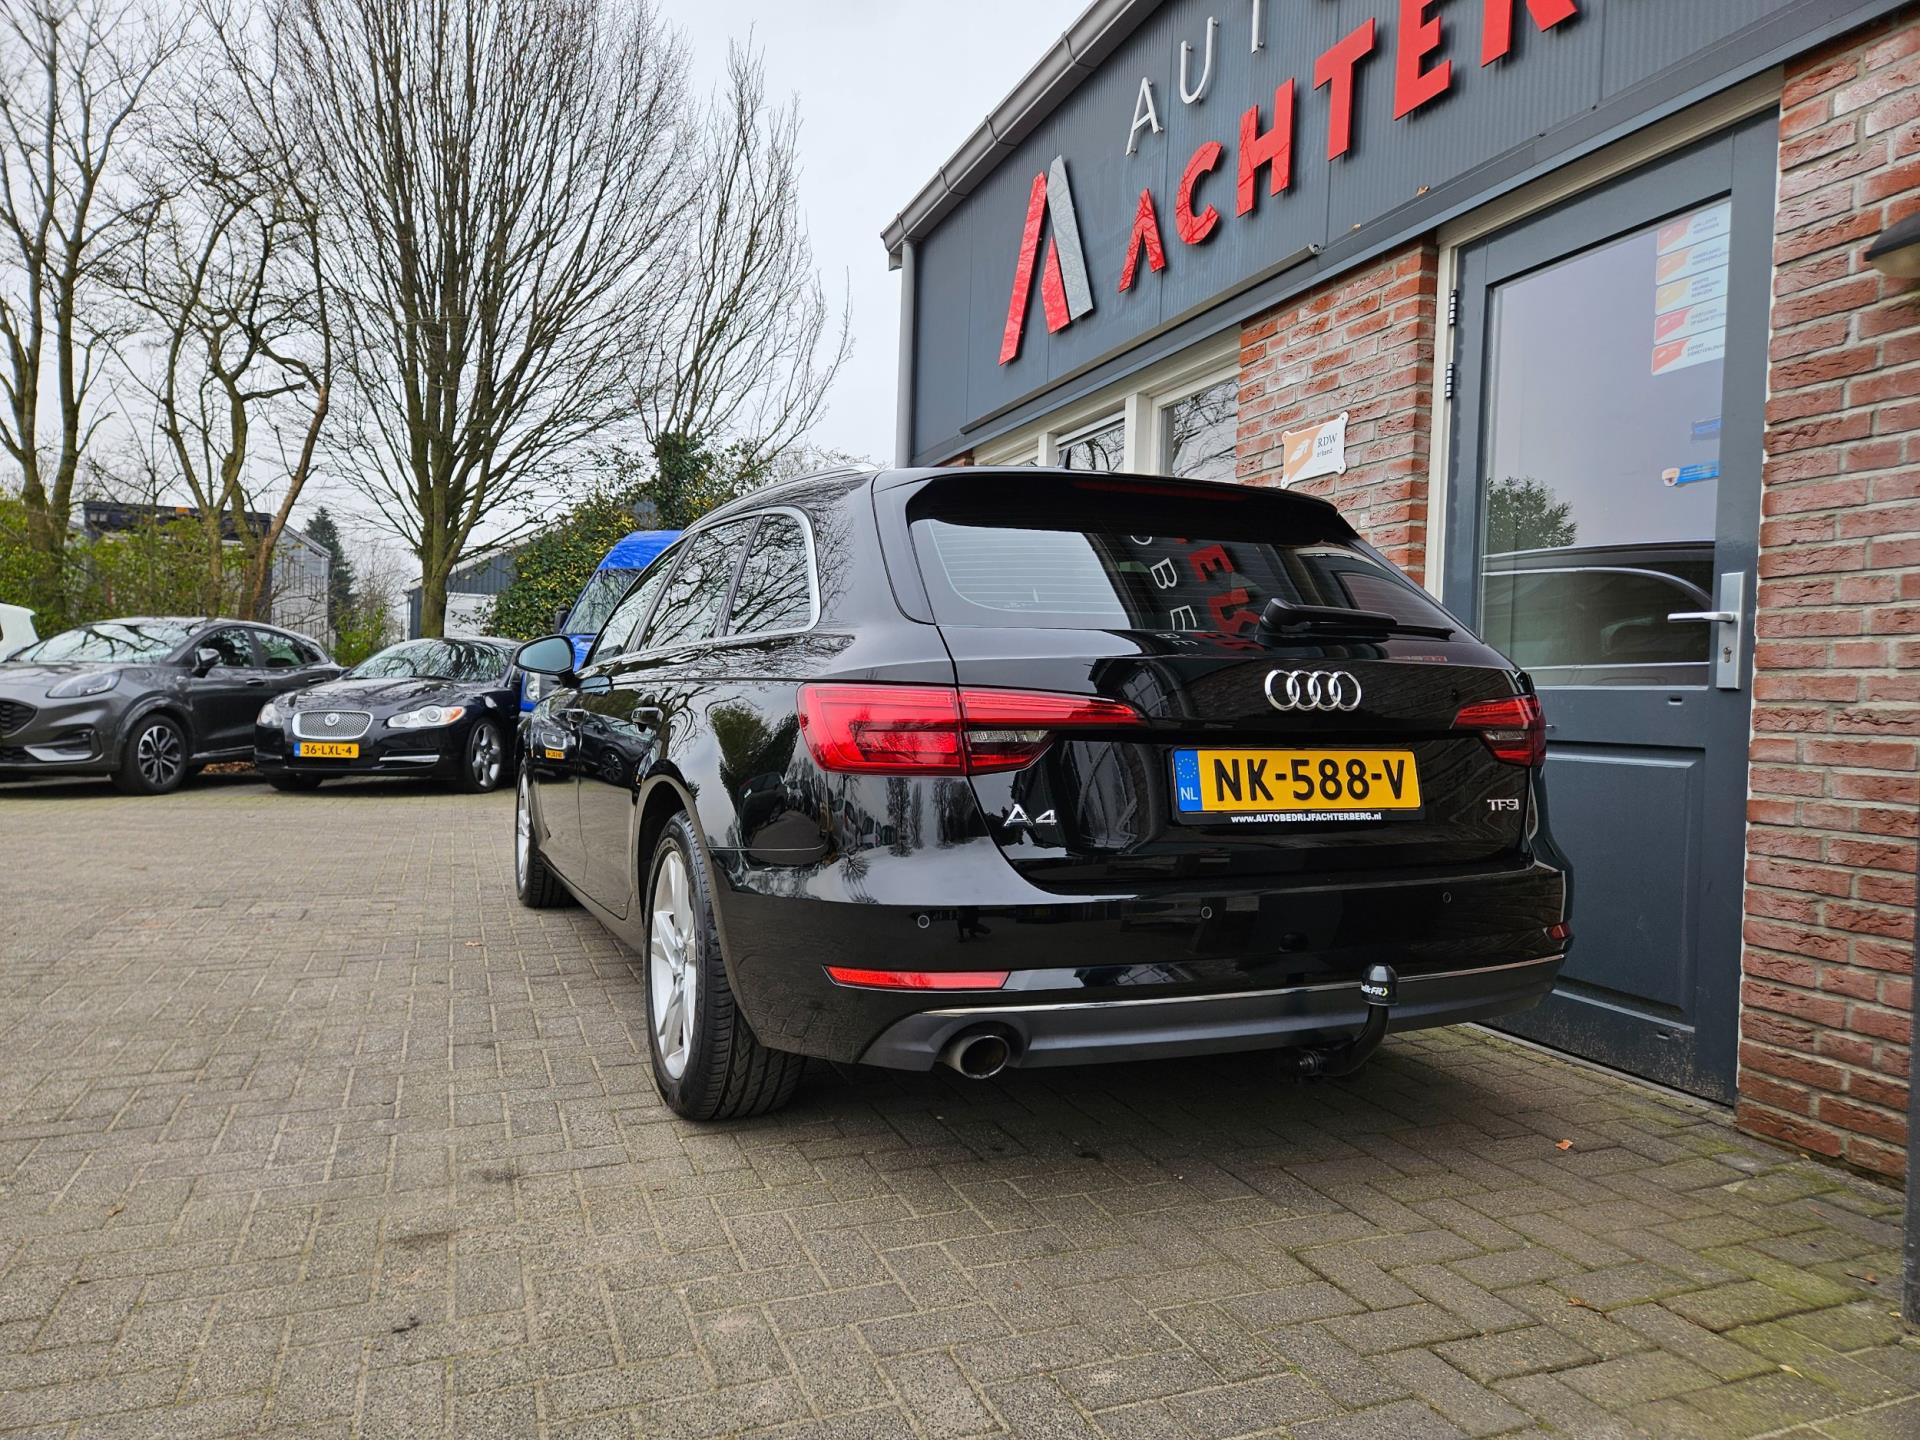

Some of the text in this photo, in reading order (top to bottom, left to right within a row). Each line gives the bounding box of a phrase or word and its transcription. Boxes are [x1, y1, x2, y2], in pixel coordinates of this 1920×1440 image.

[1317, 432, 1338, 448] RDW
[303, 744, 353, 756] 36-LXL-4
[1213, 758, 1405, 802] NK-588-V
[1180, 786, 1199, 801] NL
[1486, 798, 1520, 811] TFSI
[1003, 803, 1057, 826] A4
[1231, 812, 1382, 823] www.AUTOBEDRIJFACHTERBERG.nl
